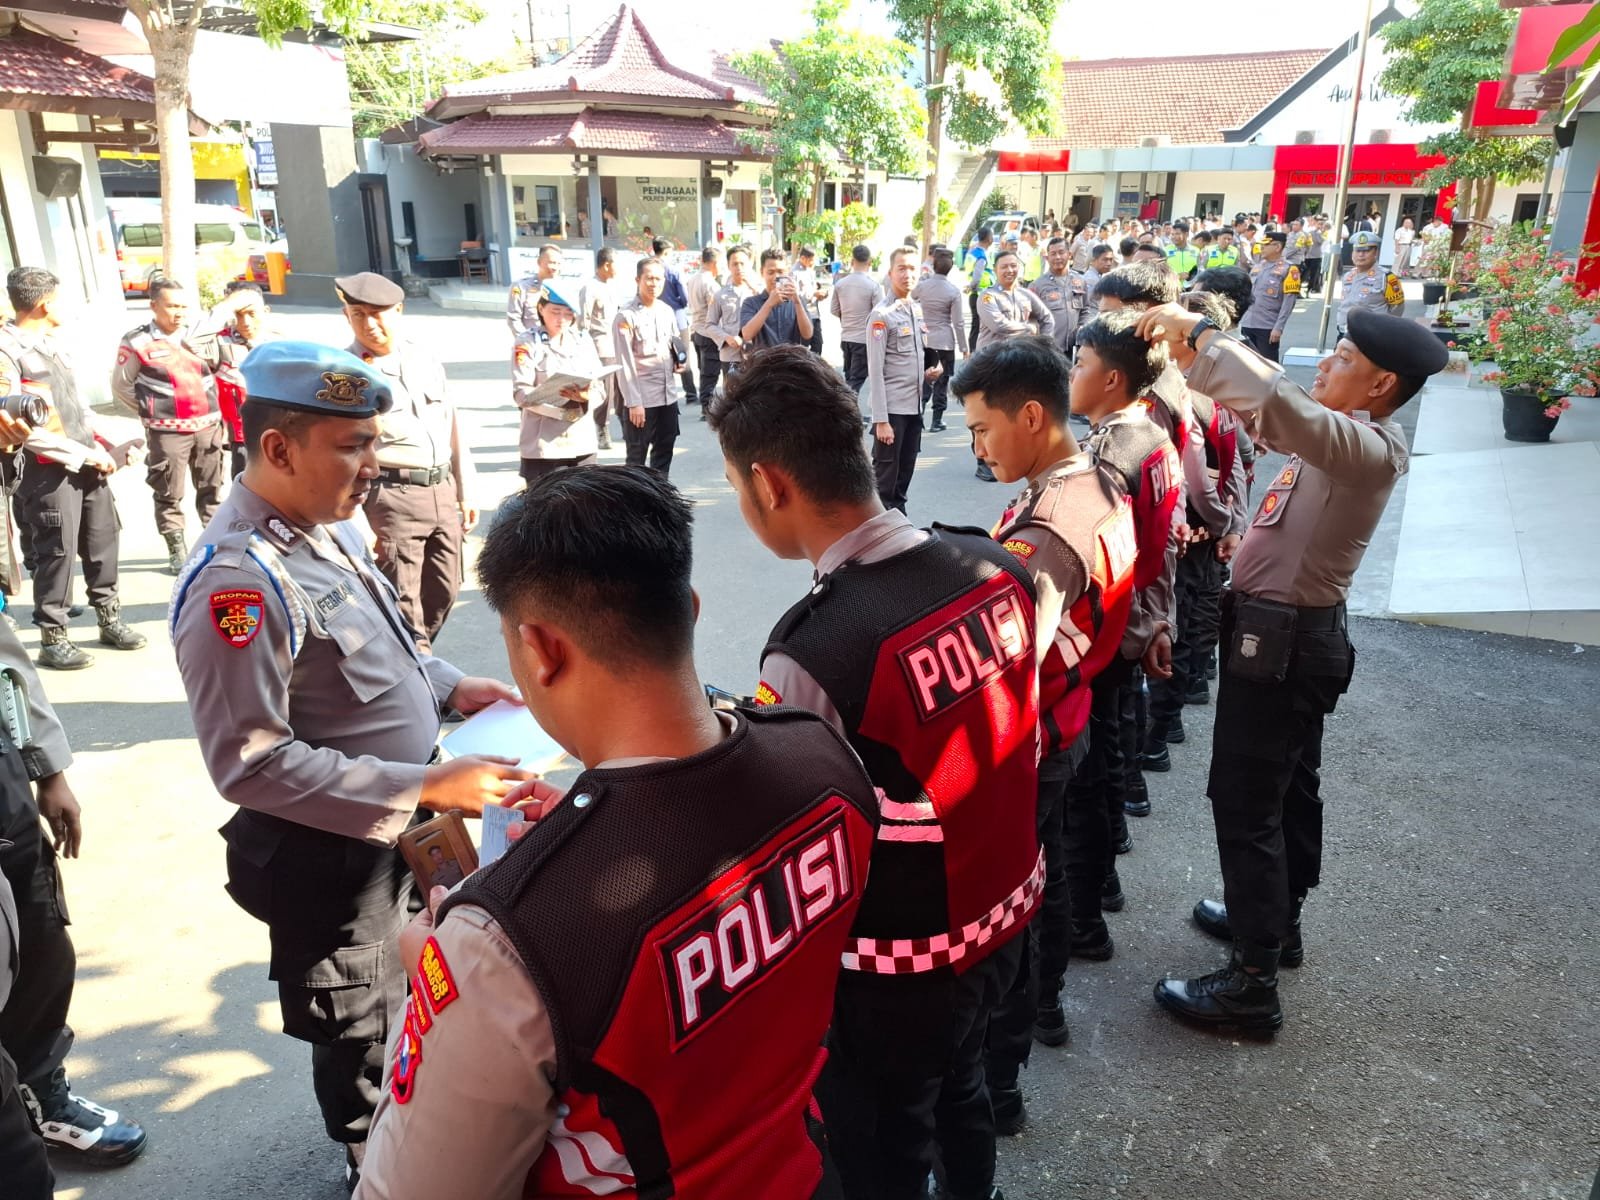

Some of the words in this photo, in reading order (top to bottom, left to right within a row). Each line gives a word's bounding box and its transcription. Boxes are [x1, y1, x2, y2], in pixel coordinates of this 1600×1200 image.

[643, 186, 697, 195] PENJAGAAN
[213, 592, 260, 602] PROPAM
[908, 593, 1030, 712] POLISI
[676, 827, 850, 1025] POLISI
